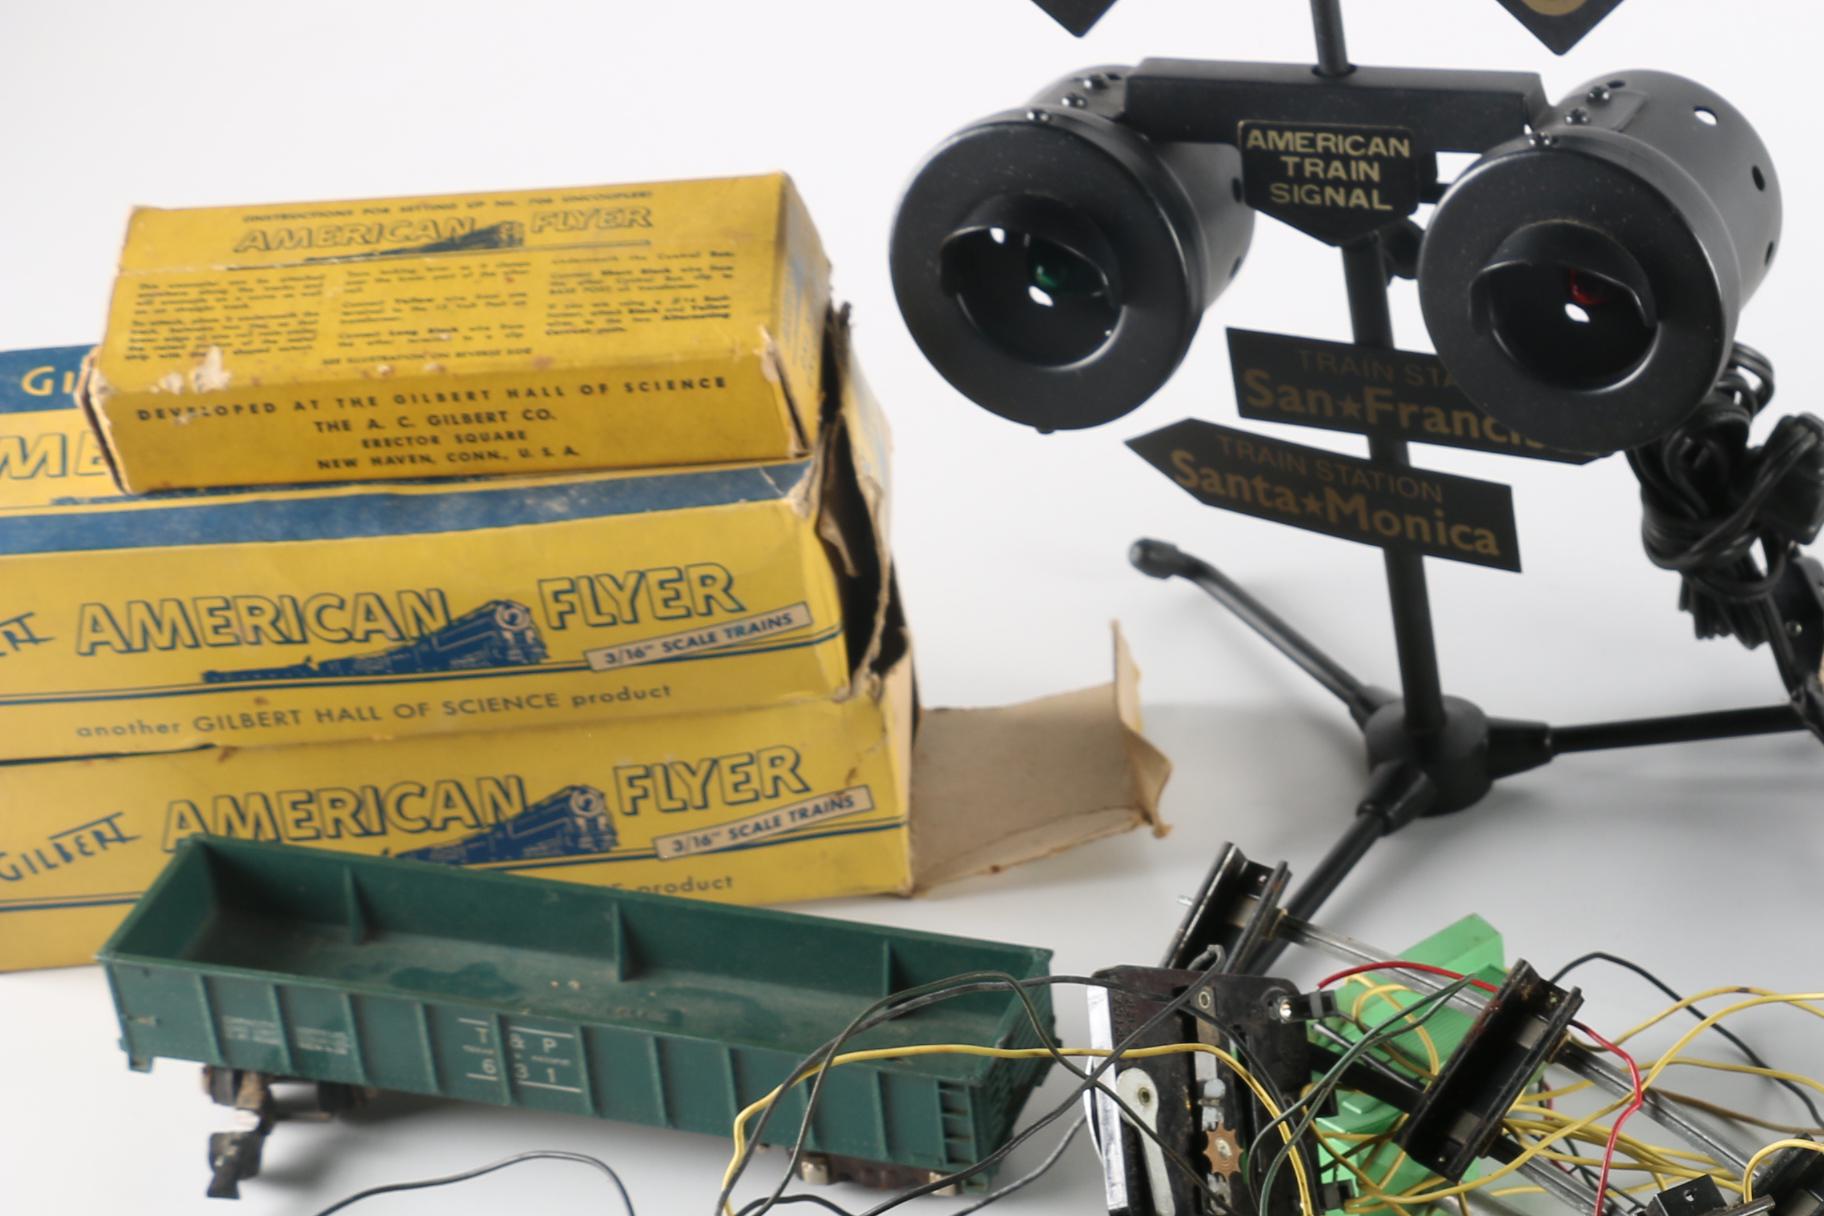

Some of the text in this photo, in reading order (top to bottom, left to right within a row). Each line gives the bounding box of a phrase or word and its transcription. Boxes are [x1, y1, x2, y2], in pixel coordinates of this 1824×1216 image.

[1247, 130, 1410, 157] AMERICAN
[1282, 157, 1381, 182] TRAIN
[1269, 182, 1392, 210] SIGNAL
[233, 207, 655, 253] AMERICAN FLYER
[1299, 350, 1394, 383] TRAIN
[137, 376, 727, 421] DEVELOPED AT THE GILBERT HALL OF SCIENCE
[1243, 367, 1335, 417] San
[314, 408, 557, 433] THE A. C. GILBERT CO.
[361, 430, 526, 449] ERECTOR SQUARE
[316, 457, 359, 470] NEW
[1217, 434, 1443, 504] TRAIN STATION
[1169, 449, 1500, 557] Santa Monica
[76, 588, 453, 657] AMERICAN
[537, 562, 747, 631] FLYER
[661, 631, 721, 654] SCALE
[725, 612, 794, 641] TRAINS
[76, 684, 674, 739] another GILBERT HALL OF SCIENCE product
[162, 744, 811, 853] AMERICAN FLYER
[728, 815, 783, 841] SCALE
[788, 794, 855, 824] TRAINS
[0, 811, 142, 883] GILBERT
